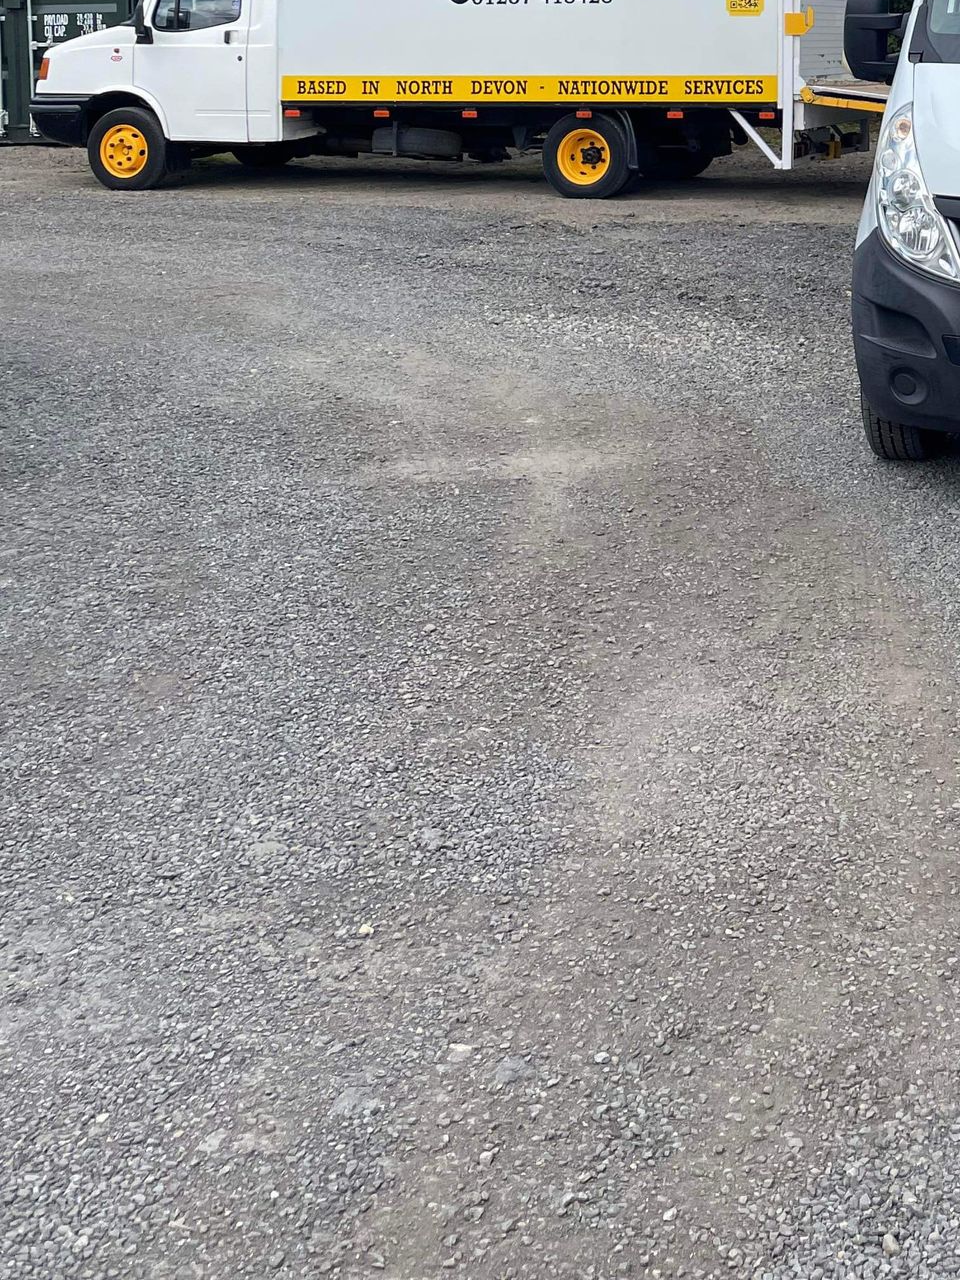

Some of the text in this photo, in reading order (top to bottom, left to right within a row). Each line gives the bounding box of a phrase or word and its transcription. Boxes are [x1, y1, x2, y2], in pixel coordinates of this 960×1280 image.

[44, 14, 69, 26] PAYLOAD
[297, 80, 346, 95] BASED
[362, 80, 380, 95] IN
[396, 80, 453, 95] NORTH
[471, 80, 528, 95] DEVON
[558, 80, 669, 95] NATIONWIDE
[684, 80, 764, 95] SERVICES
